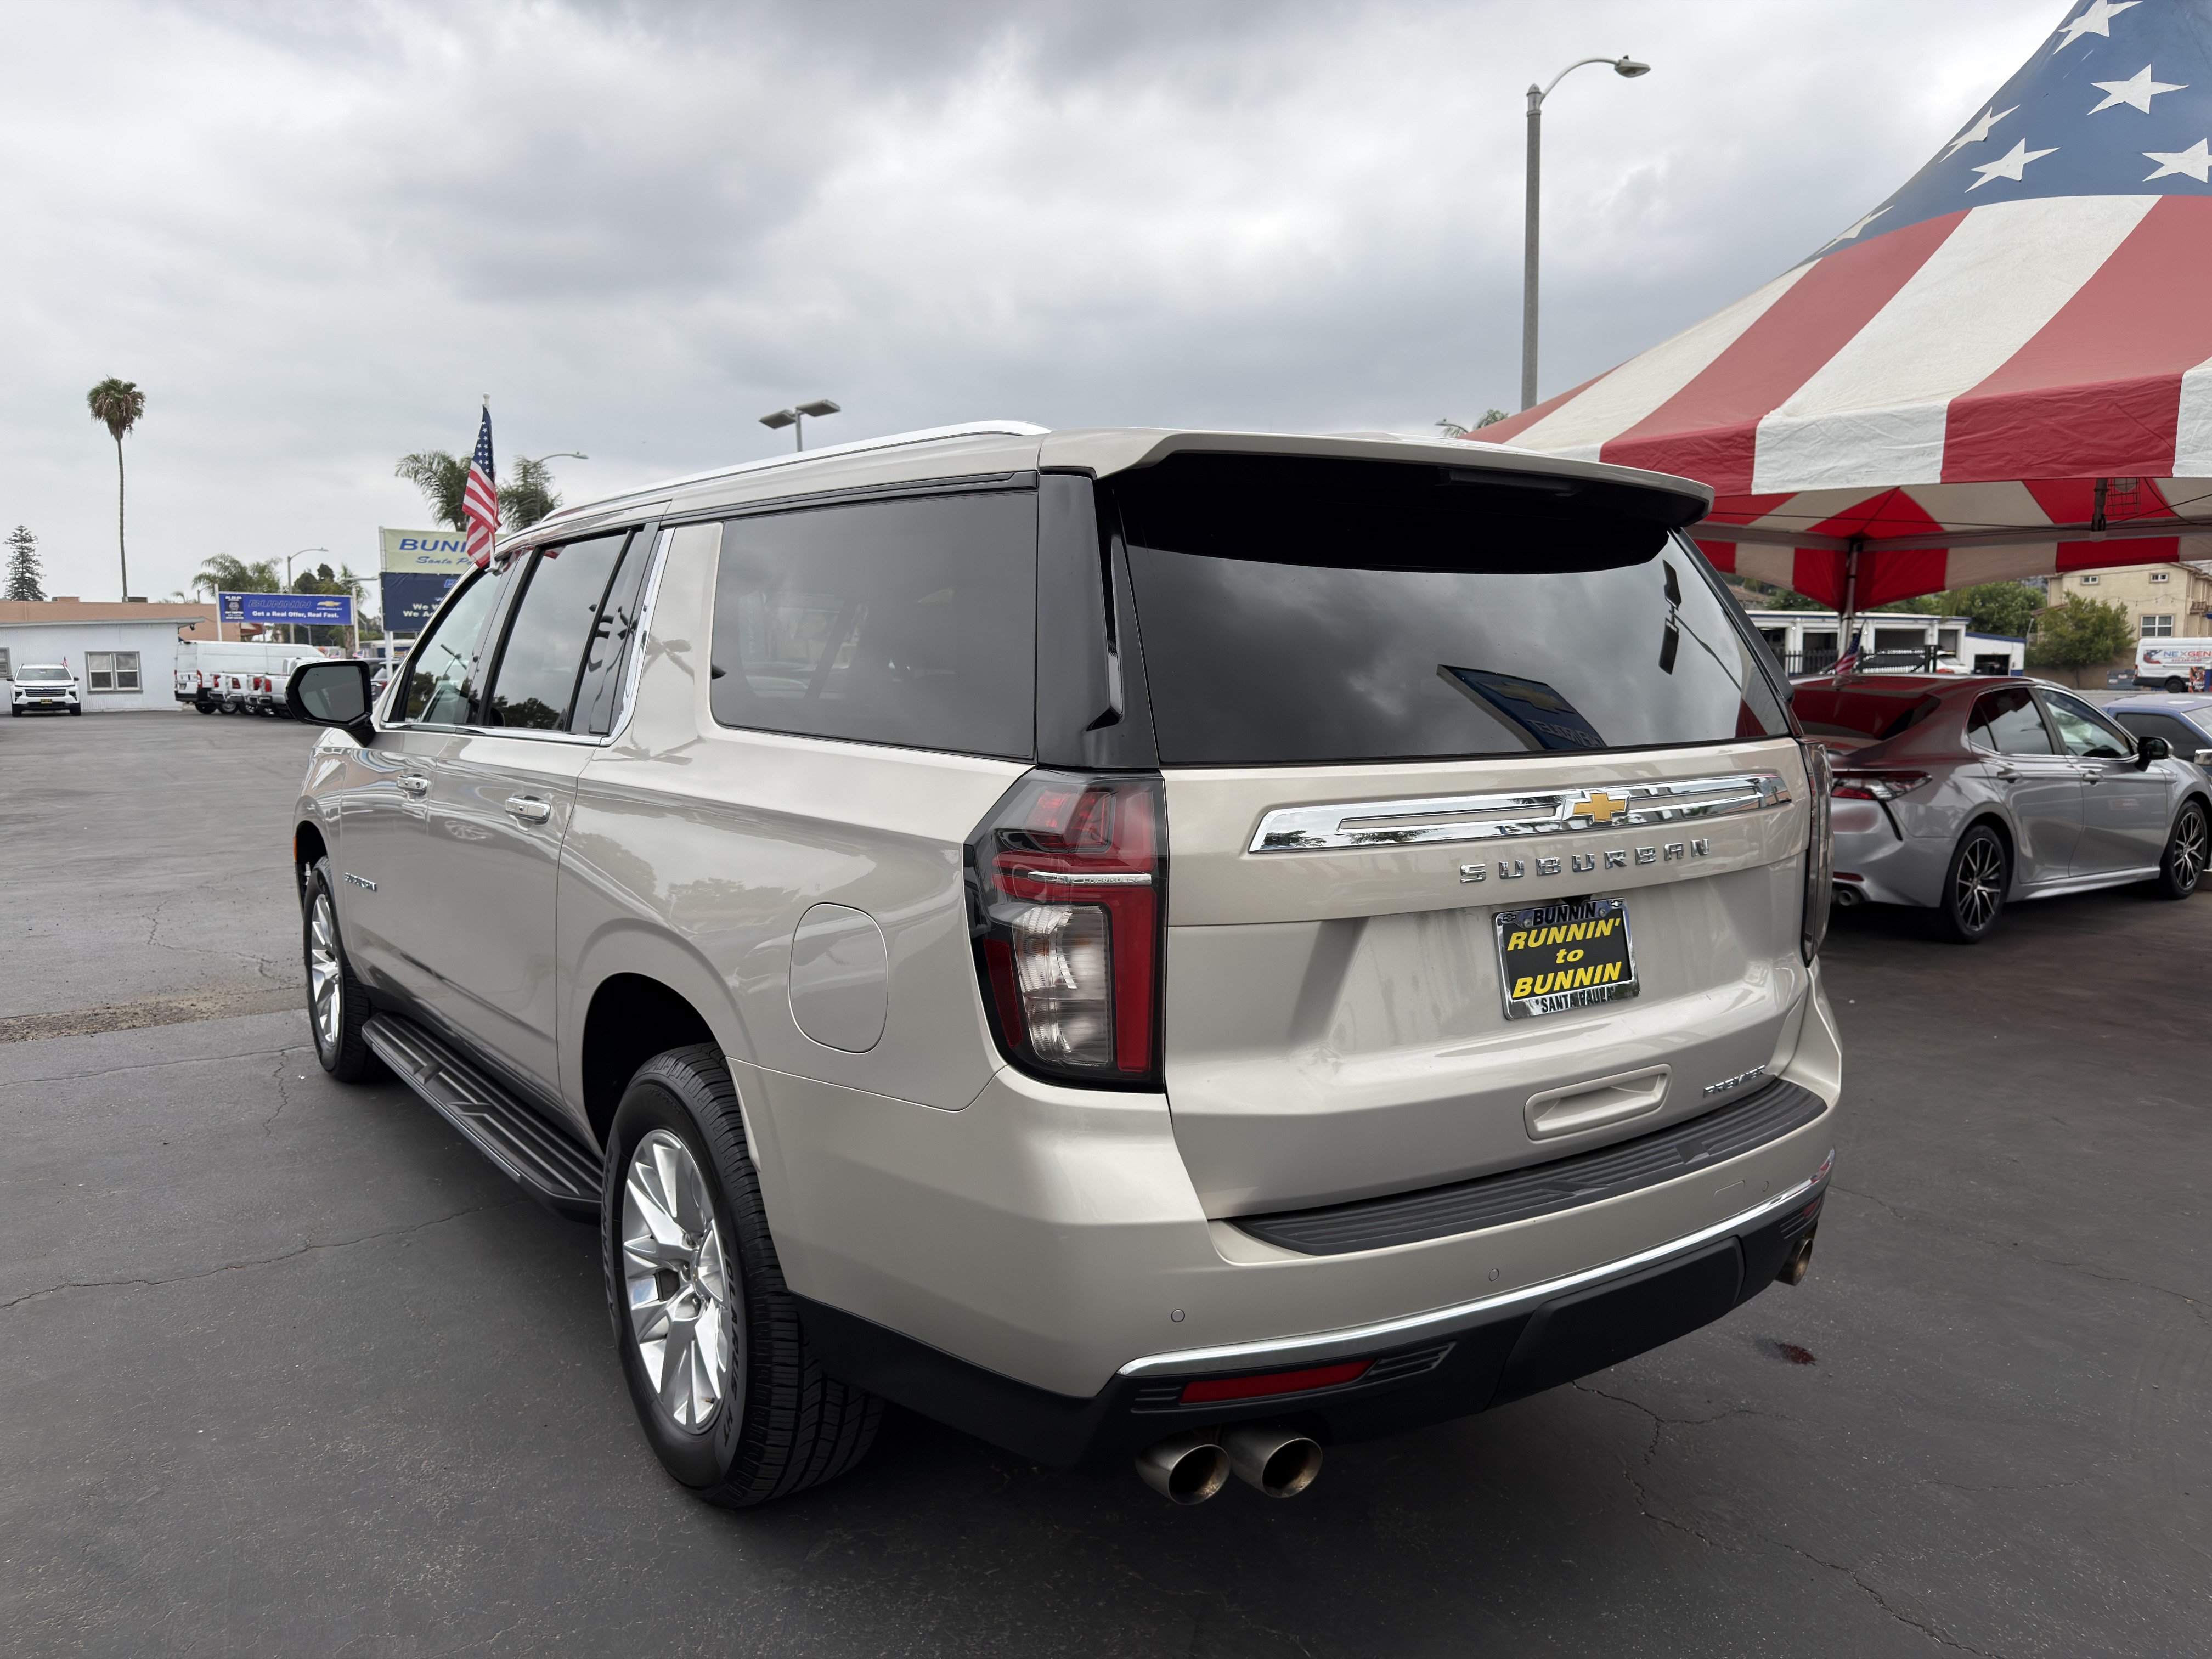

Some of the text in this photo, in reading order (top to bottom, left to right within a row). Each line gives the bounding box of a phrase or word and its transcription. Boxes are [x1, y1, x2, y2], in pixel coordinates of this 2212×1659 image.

[248, 600, 311, 609] BUNNIN
[1460, 838, 1710, 883] SUBURBAN
[1533, 902, 1596, 926] BUNNIN
[1507, 918, 1621, 951] RUNNIN'
[1556, 949, 1584, 964] to
[1512, 961, 1622, 998] BUNNIN
[1541, 987, 1613, 1013] SANTA PAULA
